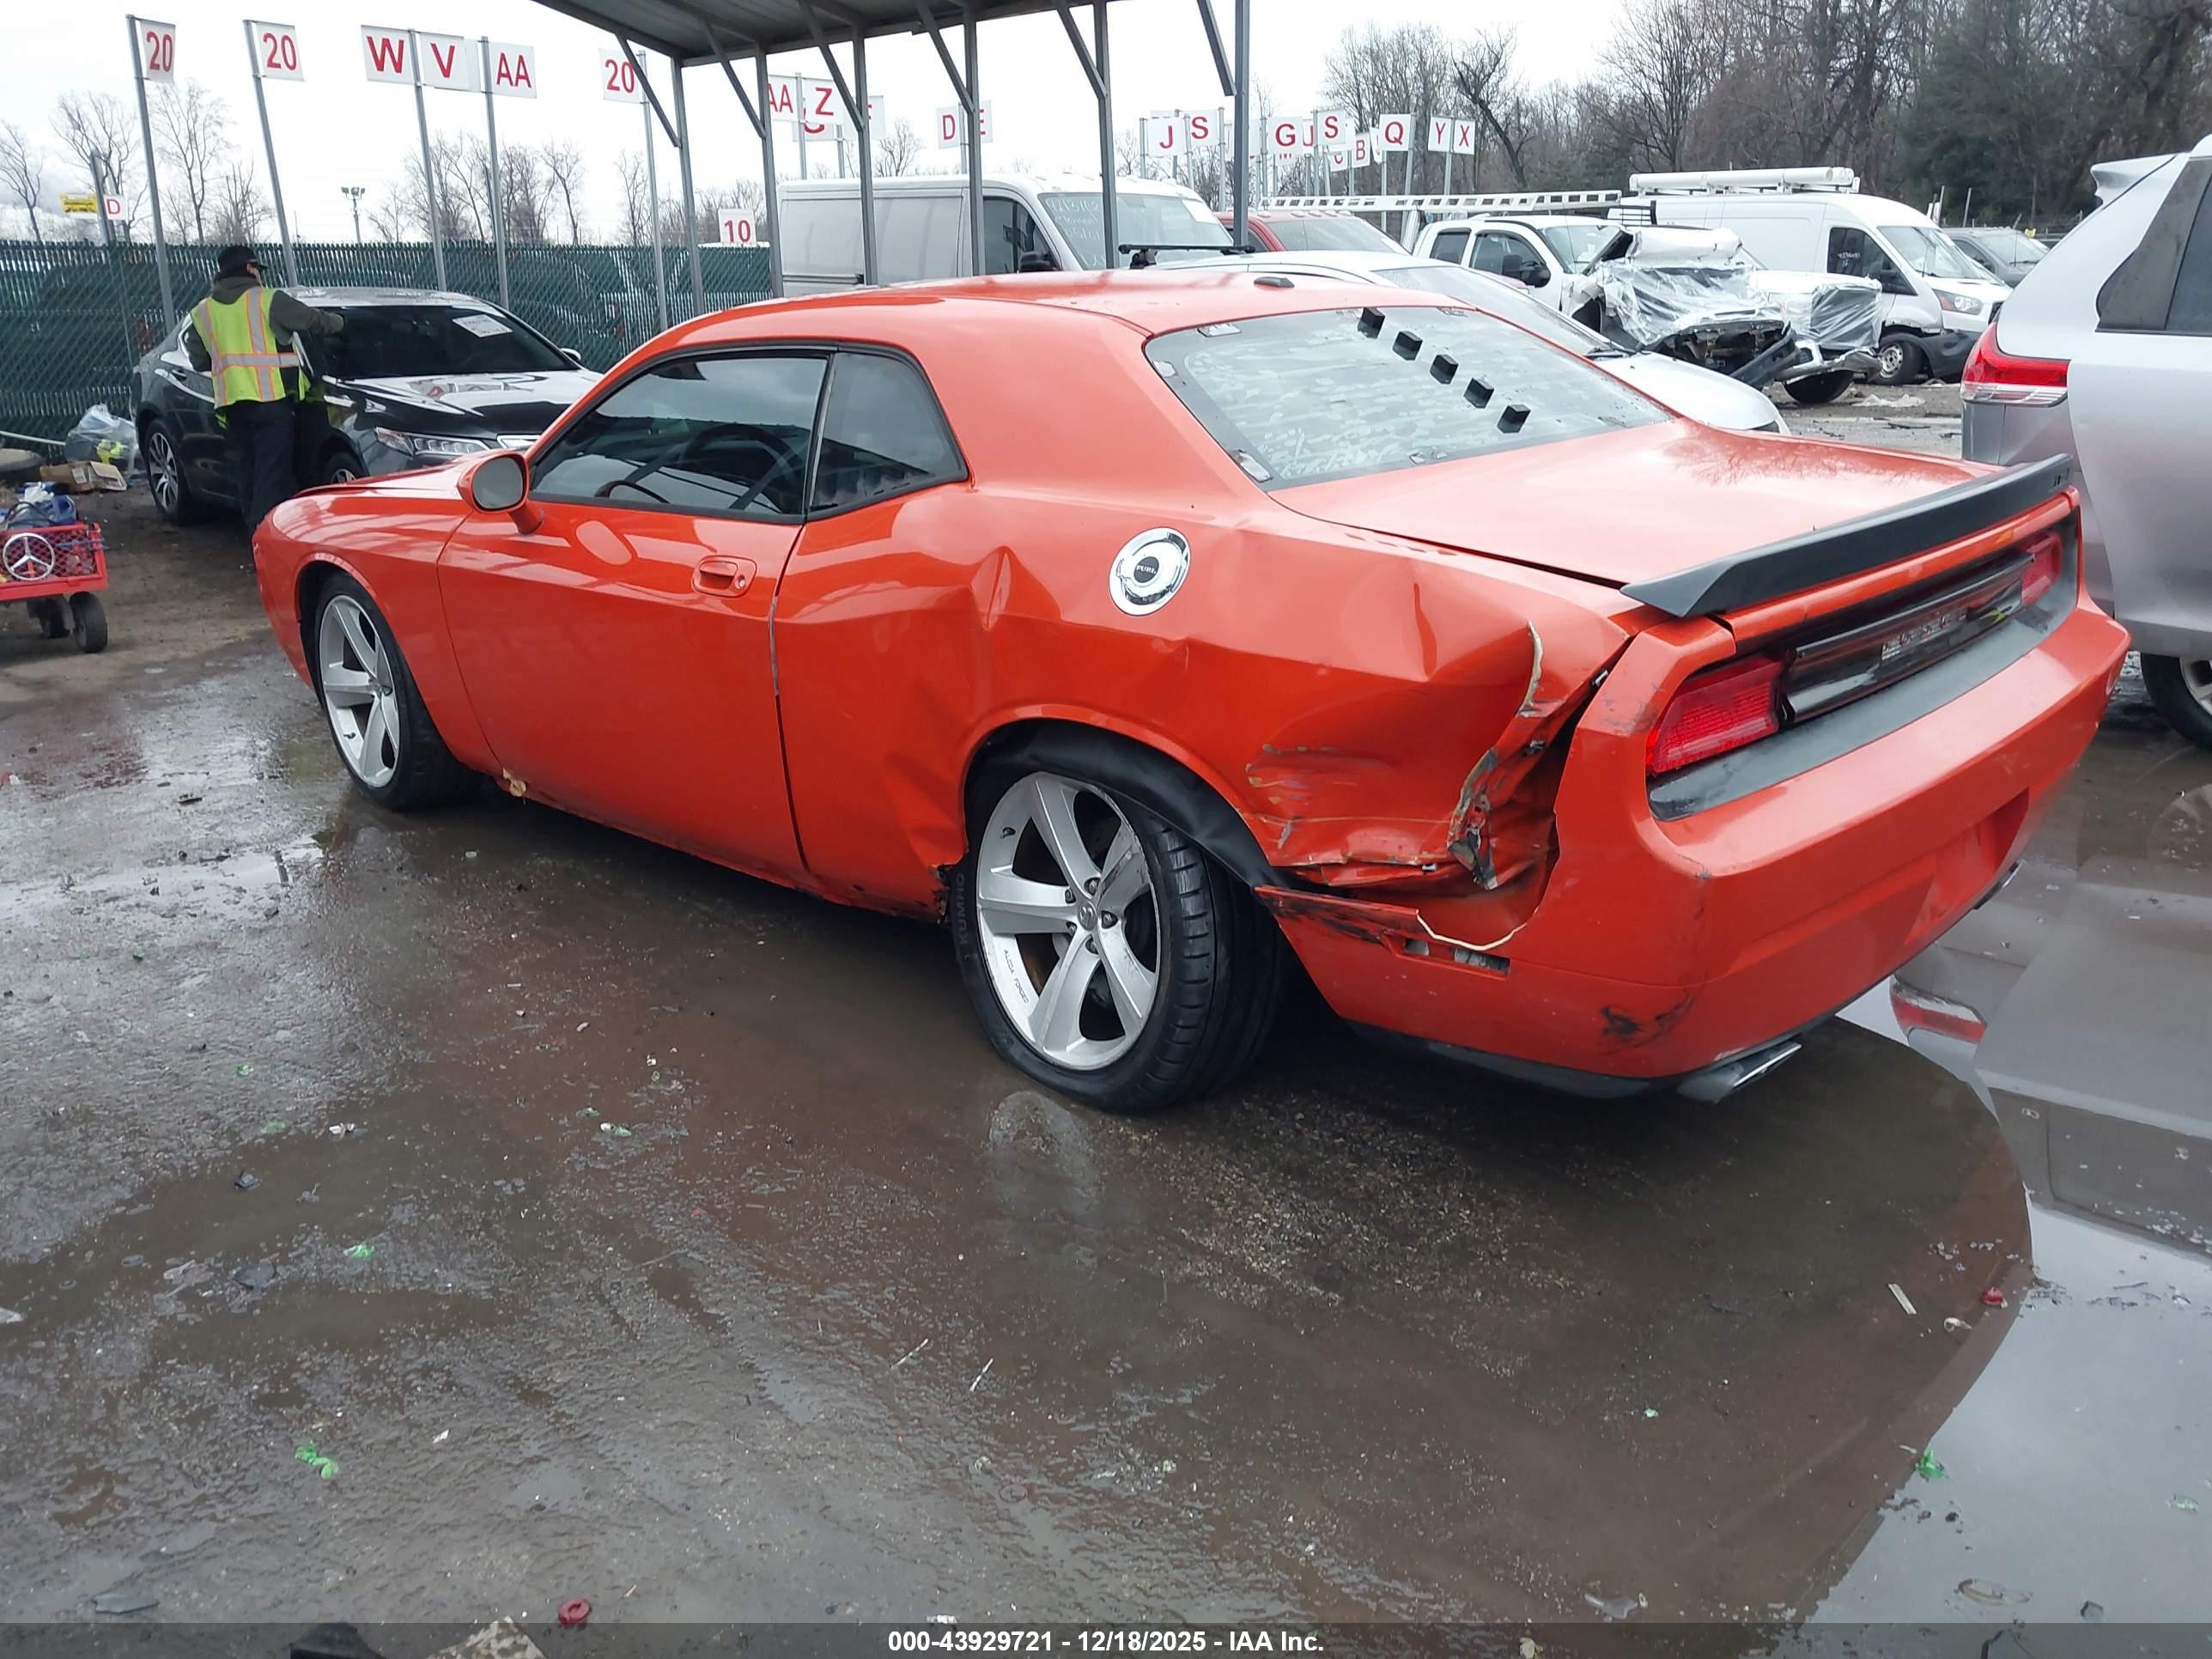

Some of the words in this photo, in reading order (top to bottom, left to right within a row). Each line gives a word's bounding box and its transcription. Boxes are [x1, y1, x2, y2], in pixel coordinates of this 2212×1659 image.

[146, 31, 173, 72] 20
[263, 32, 298, 71] 20
[366, 35, 404, 75] W
[430, 42, 456, 79] V
[496, 52, 532, 88] AA
[604, 58, 635, 94] 20
[815, 87, 834, 116] Z
[942, 113, 956, 141] D
[1158, 125, 1174, 149] J
[1191, 115, 1209, 140] S
[1275, 123, 1297, 147] G
[1324, 115, 1339, 139] S
[1384, 121, 1404, 145] Q
[1435, 123, 1446, 144] Y
[1459, 125, 1470, 147] X
[1356, 140, 1366, 161] B
[106, 198, 121, 215] D
[724, 219, 751, 243] 10
